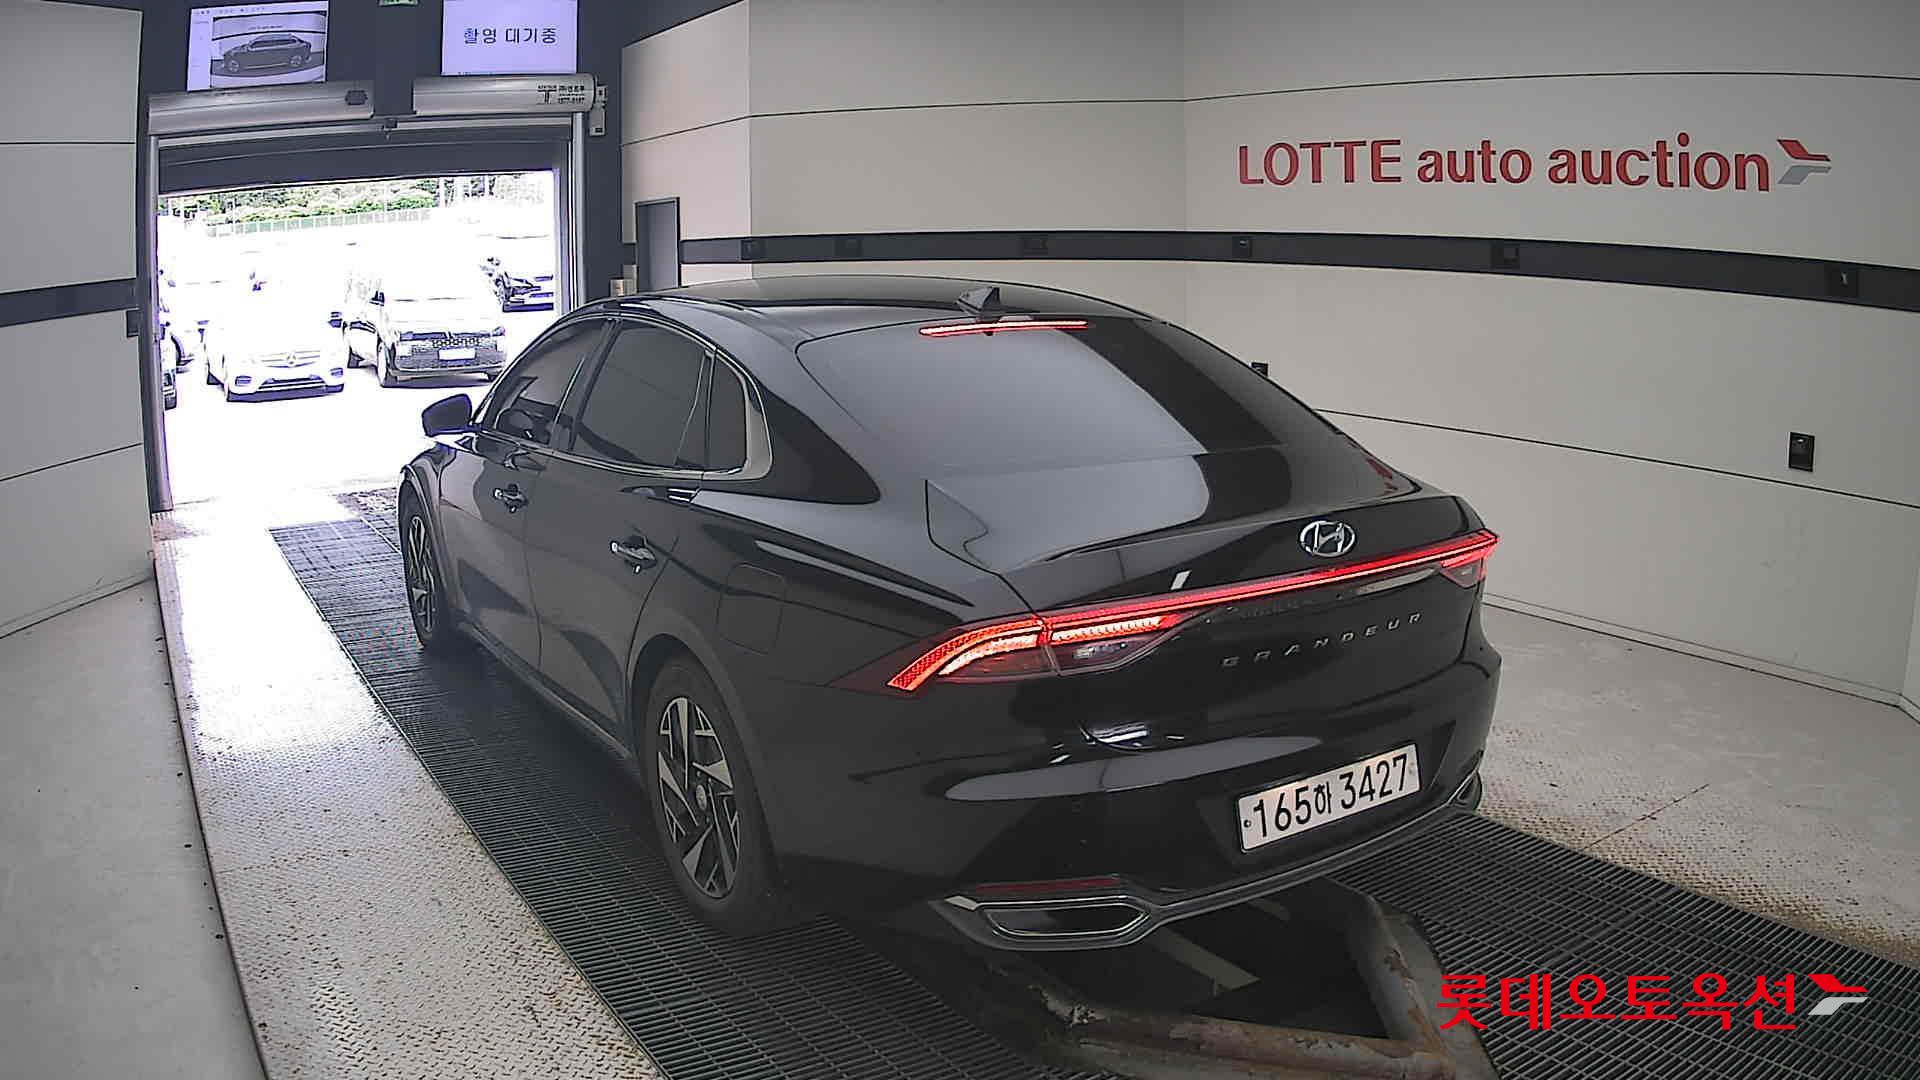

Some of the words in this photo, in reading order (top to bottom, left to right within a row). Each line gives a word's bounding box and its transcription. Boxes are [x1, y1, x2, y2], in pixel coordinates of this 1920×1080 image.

[464, 27, 498, 44] 촬영
[505, 27, 557, 44] 대기중
[1239, 139, 1402, 186] LOTTE
[1417, 139, 1532, 185] auto
[1548, 132, 1770, 192] auction
[1222, 612, 1421, 667] GRANDEUR
[1253, 781, 1332, 838] 165하
[1339, 753, 1408, 810] 3427
